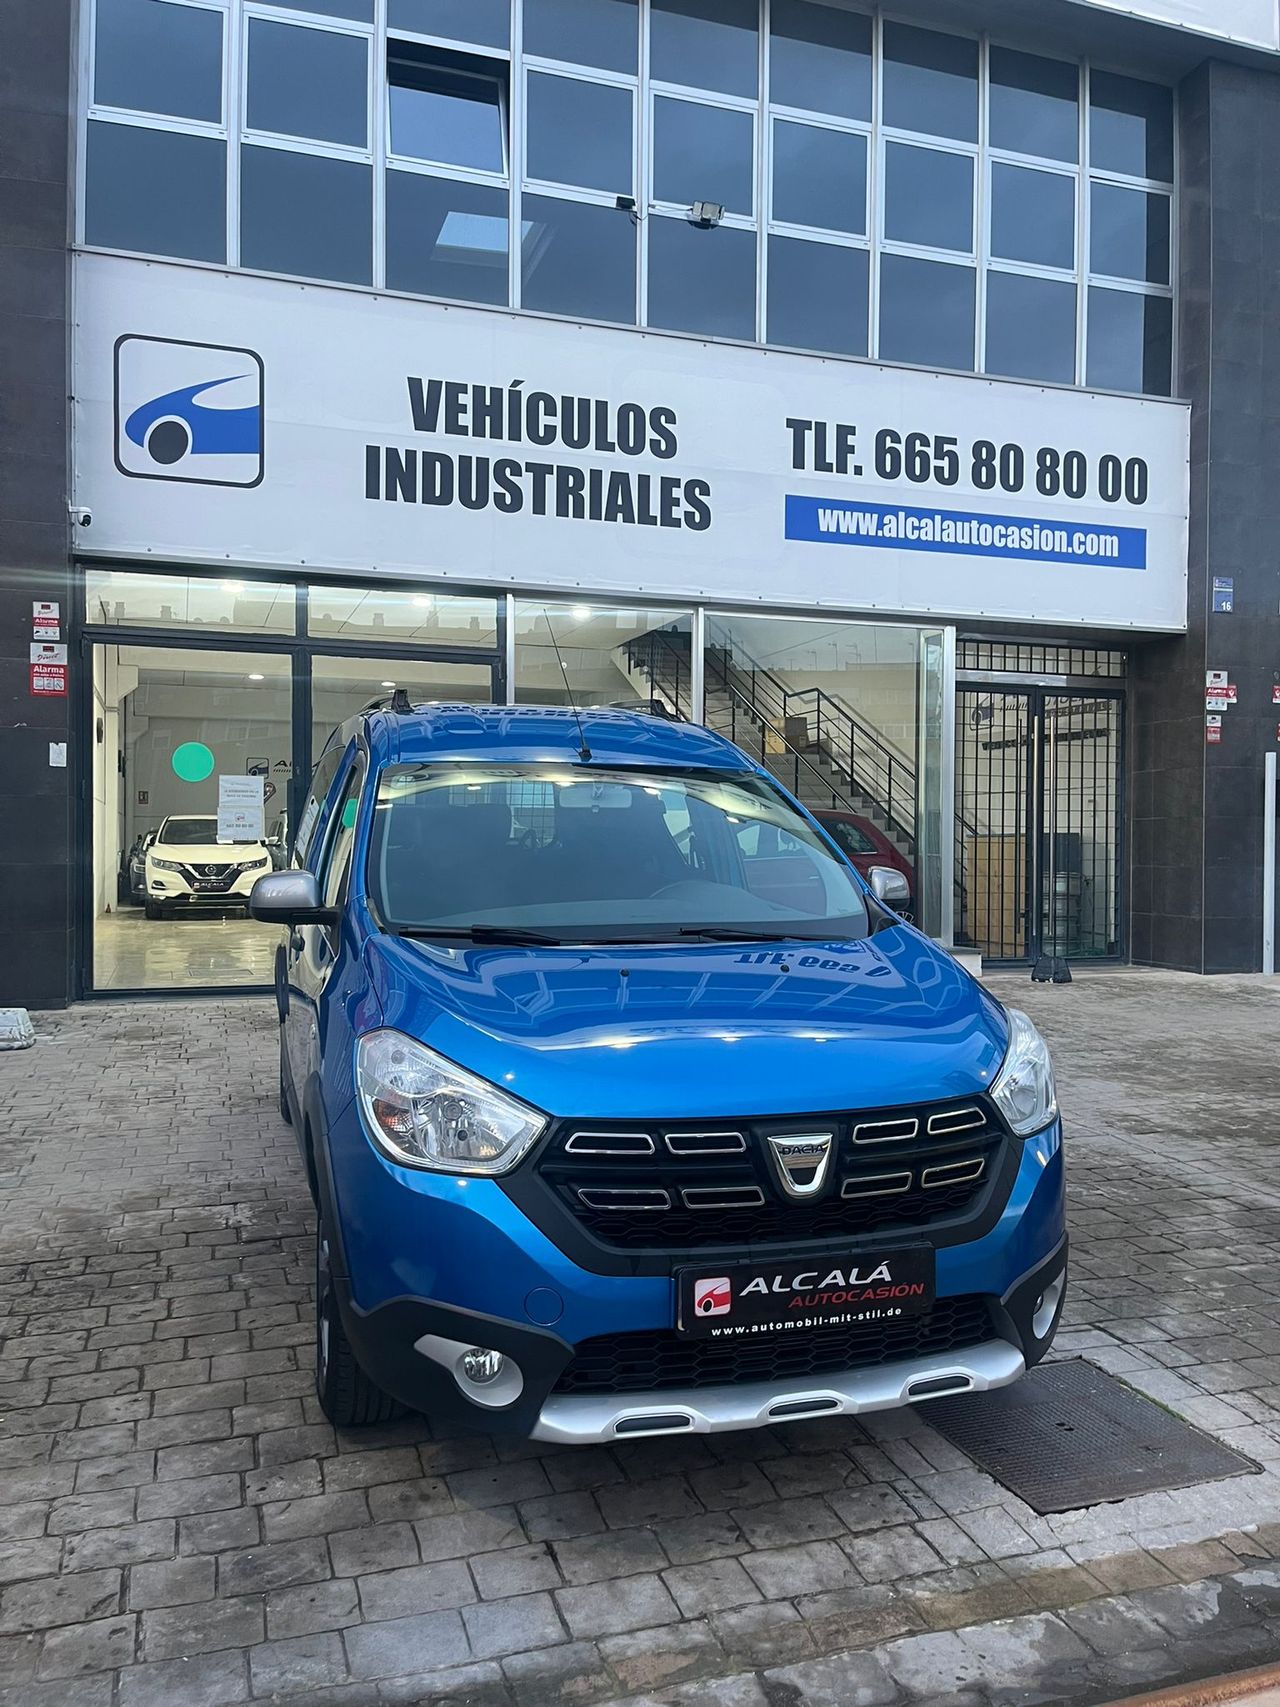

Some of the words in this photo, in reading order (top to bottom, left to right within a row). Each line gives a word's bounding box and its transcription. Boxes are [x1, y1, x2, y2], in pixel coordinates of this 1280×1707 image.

[407, 377, 678, 460] VEHÍCULOS
[786, 418, 863, 476] TLF.
[874, 429, 960, 486] 665
[971, 440, 1024, 493] 80
[1035, 447, 1087, 500] 80
[1098, 454, 1148, 506] 00
[365, 445, 712, 531] INDUSTRIALES
[817, 508, 1119, 558] www.alcalautocasion.com
[1221, 602, 1232, 611] 16
[33, 665, 64, 673] Alarma
[782, 1145, 825, 1156] DACIA
[739, 1260, 892, 1297] ALCALÁ
[788, 1283, 925, 1309] AUTOCASIÓN
[711, 1307, 902, 1336] www.automobil-mit-stil.de
